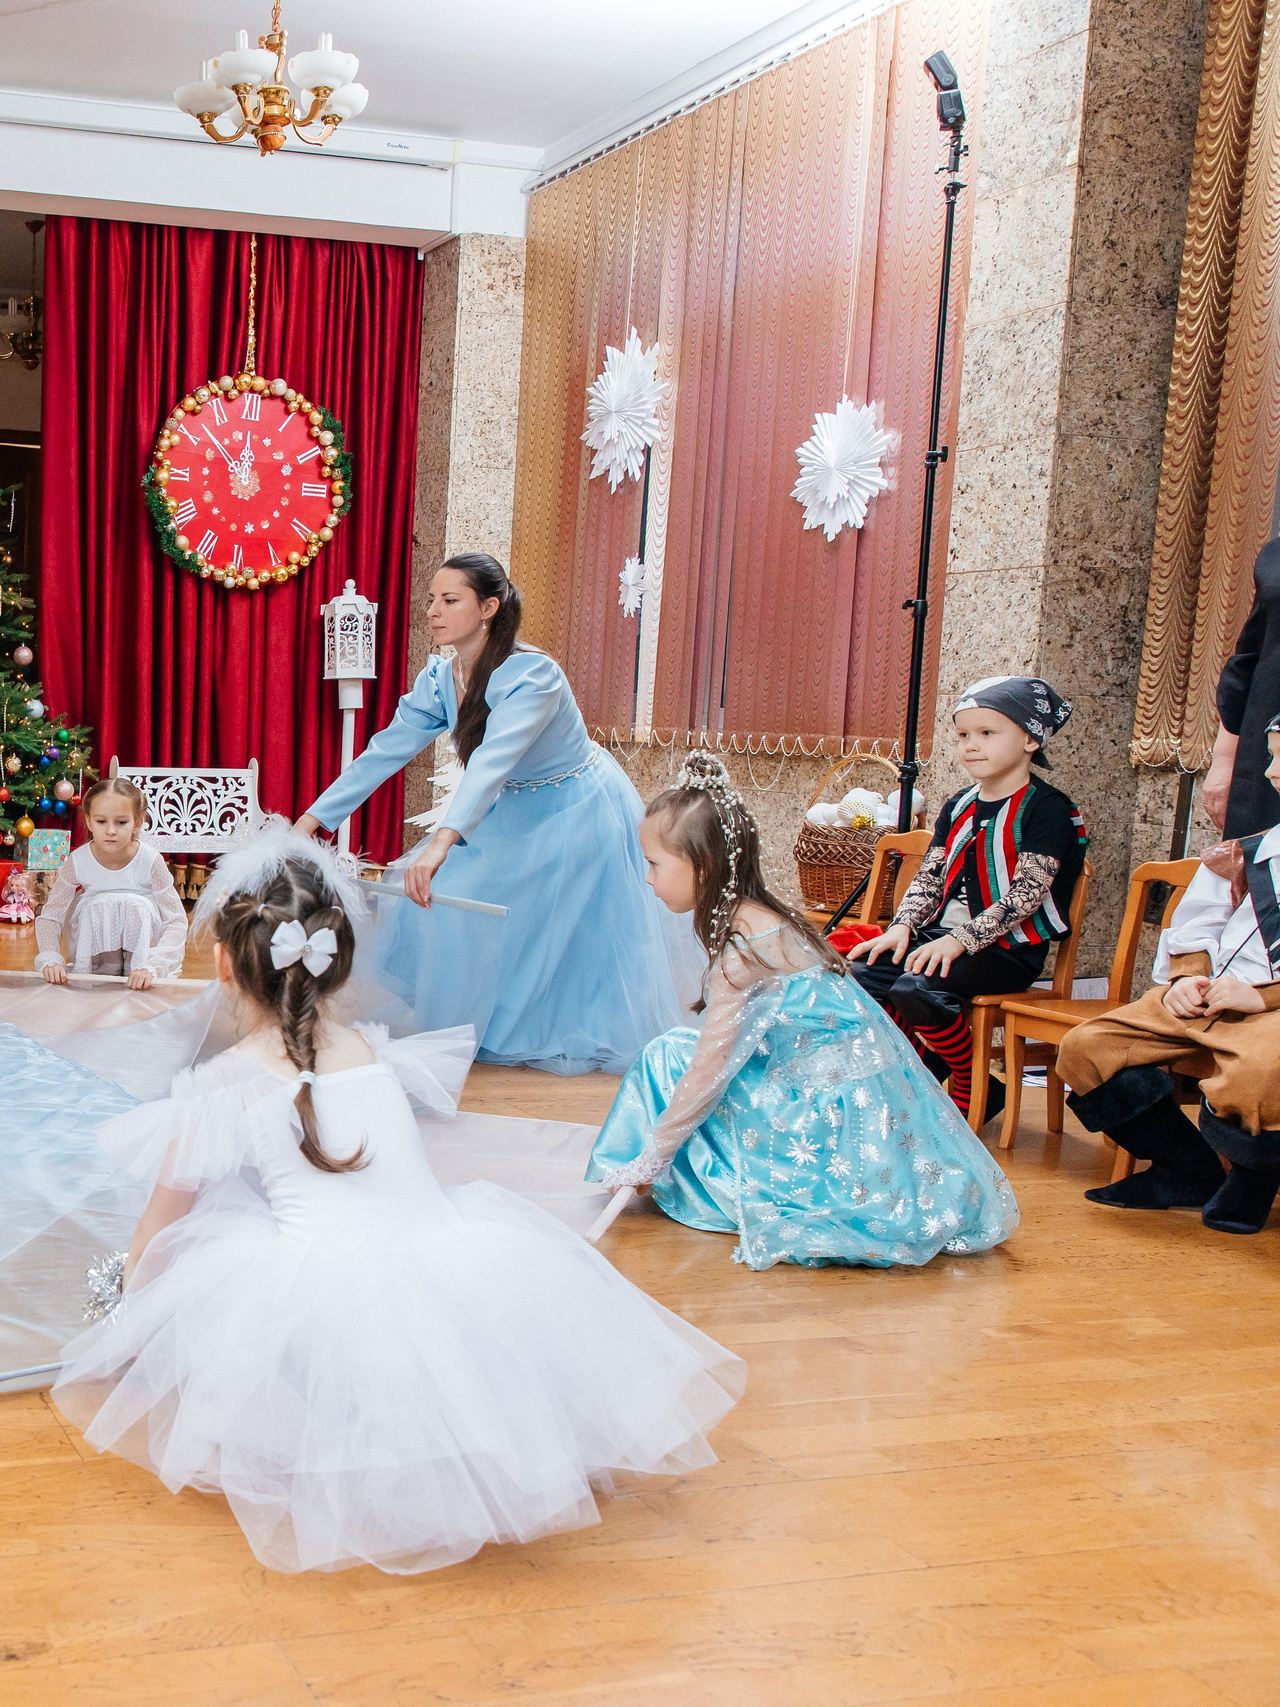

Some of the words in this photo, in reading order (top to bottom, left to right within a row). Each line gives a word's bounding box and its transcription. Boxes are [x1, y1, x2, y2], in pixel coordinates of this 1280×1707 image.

[207, 398, 229, 426] XI
[241, 392, 261, 422] XII
[177, 423, 201, 447] X
[296, 445, 321, 465] II
[170, 466, 190, 482] IX
[301, 482, 328, 498] III
[267, 541, 282, 567] V
